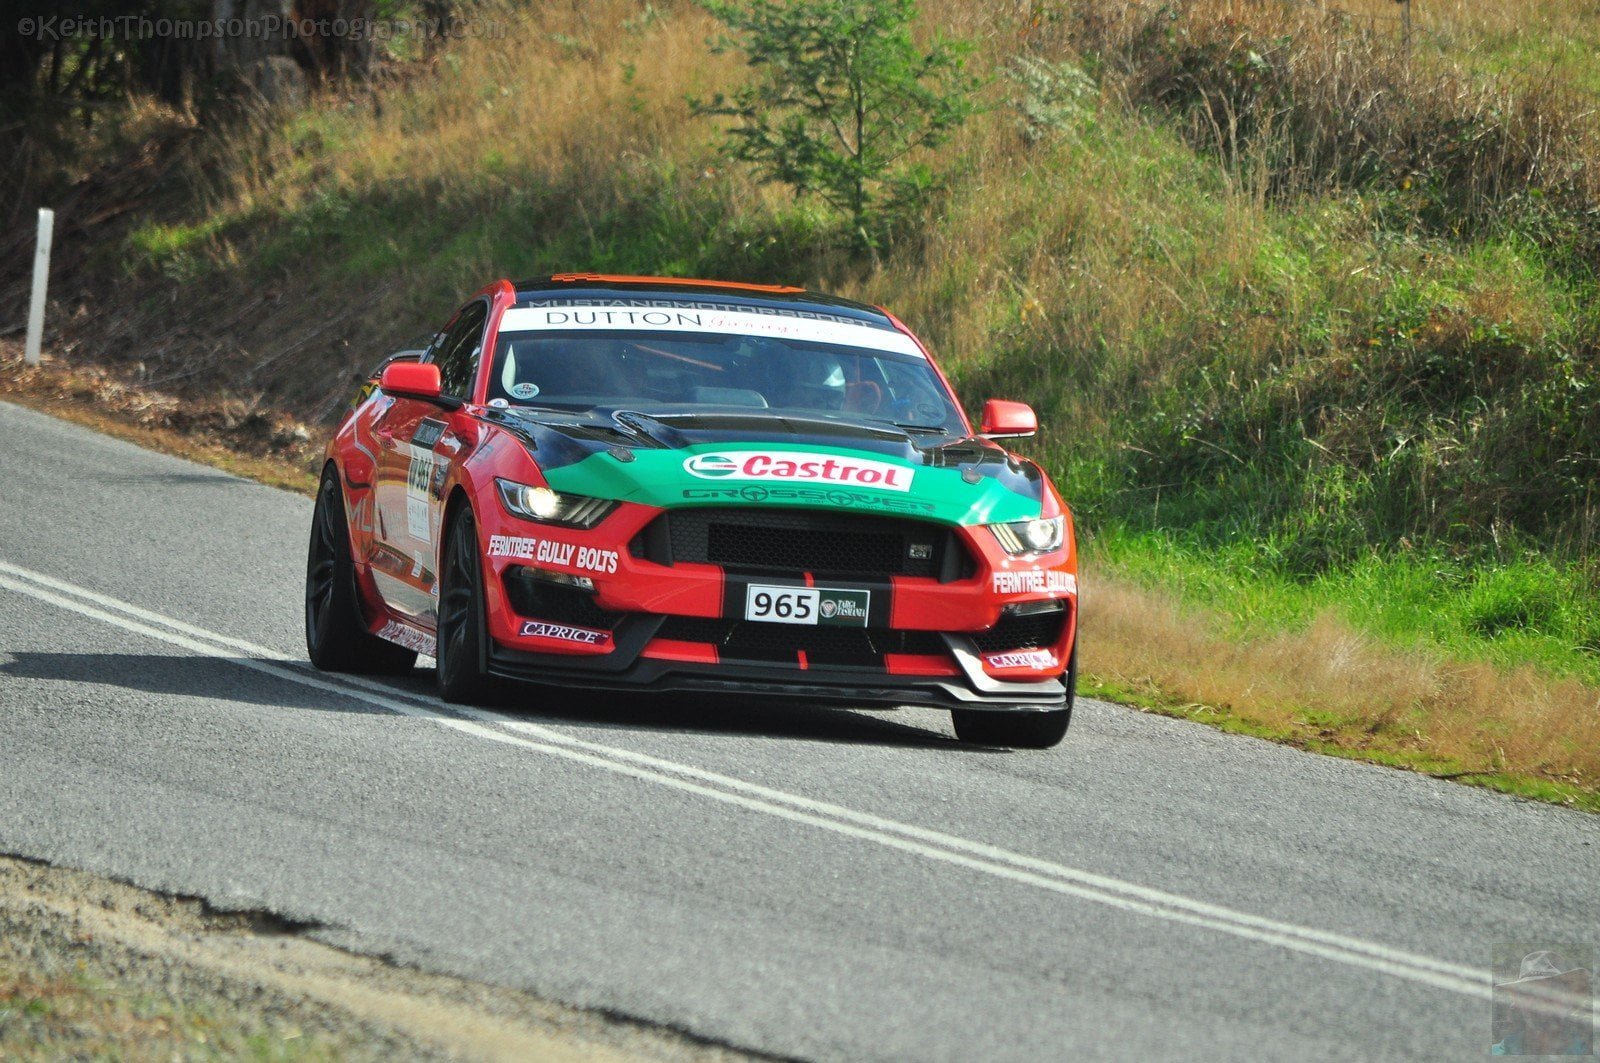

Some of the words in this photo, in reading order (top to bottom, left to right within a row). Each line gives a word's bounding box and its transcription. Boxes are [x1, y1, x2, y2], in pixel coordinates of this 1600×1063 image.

[546, 311, 702, 327] DUTTON
[742, 455, 900, 487] Castrol
[487, 534, 536, 560] FERNTREE
[537, 540, 576, 566] GULLY
[576, 546, 619, 574] BOLTS
[993, 570, 1045, 595] FERNTREE
[754, 592, 813, 619] 965
[523, 622, 597, 644] CAPRICE
